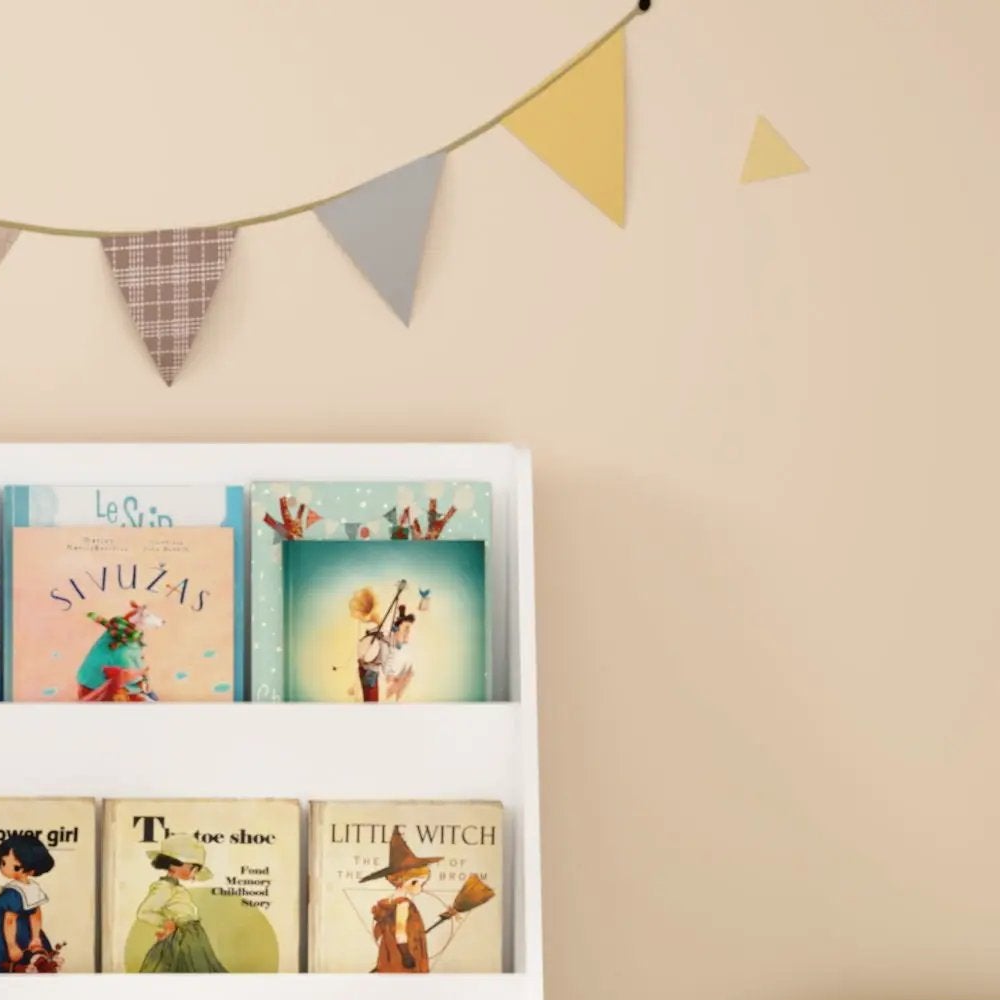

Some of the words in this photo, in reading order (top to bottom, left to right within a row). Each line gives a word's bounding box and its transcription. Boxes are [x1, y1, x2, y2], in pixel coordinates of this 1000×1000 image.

[50, 562, 210, 612] SIVUŽAS
[47, 826, 79, 847] girl
[229, 829, 276, 845] shoe
[416, 824, 497, 845] WITCH
[241, 865, 269, 876] Fond
[225, 876, 272, 888] Memory
[211, 887, 269, 897] Childhood
[240, 898, 271, 910] Story
